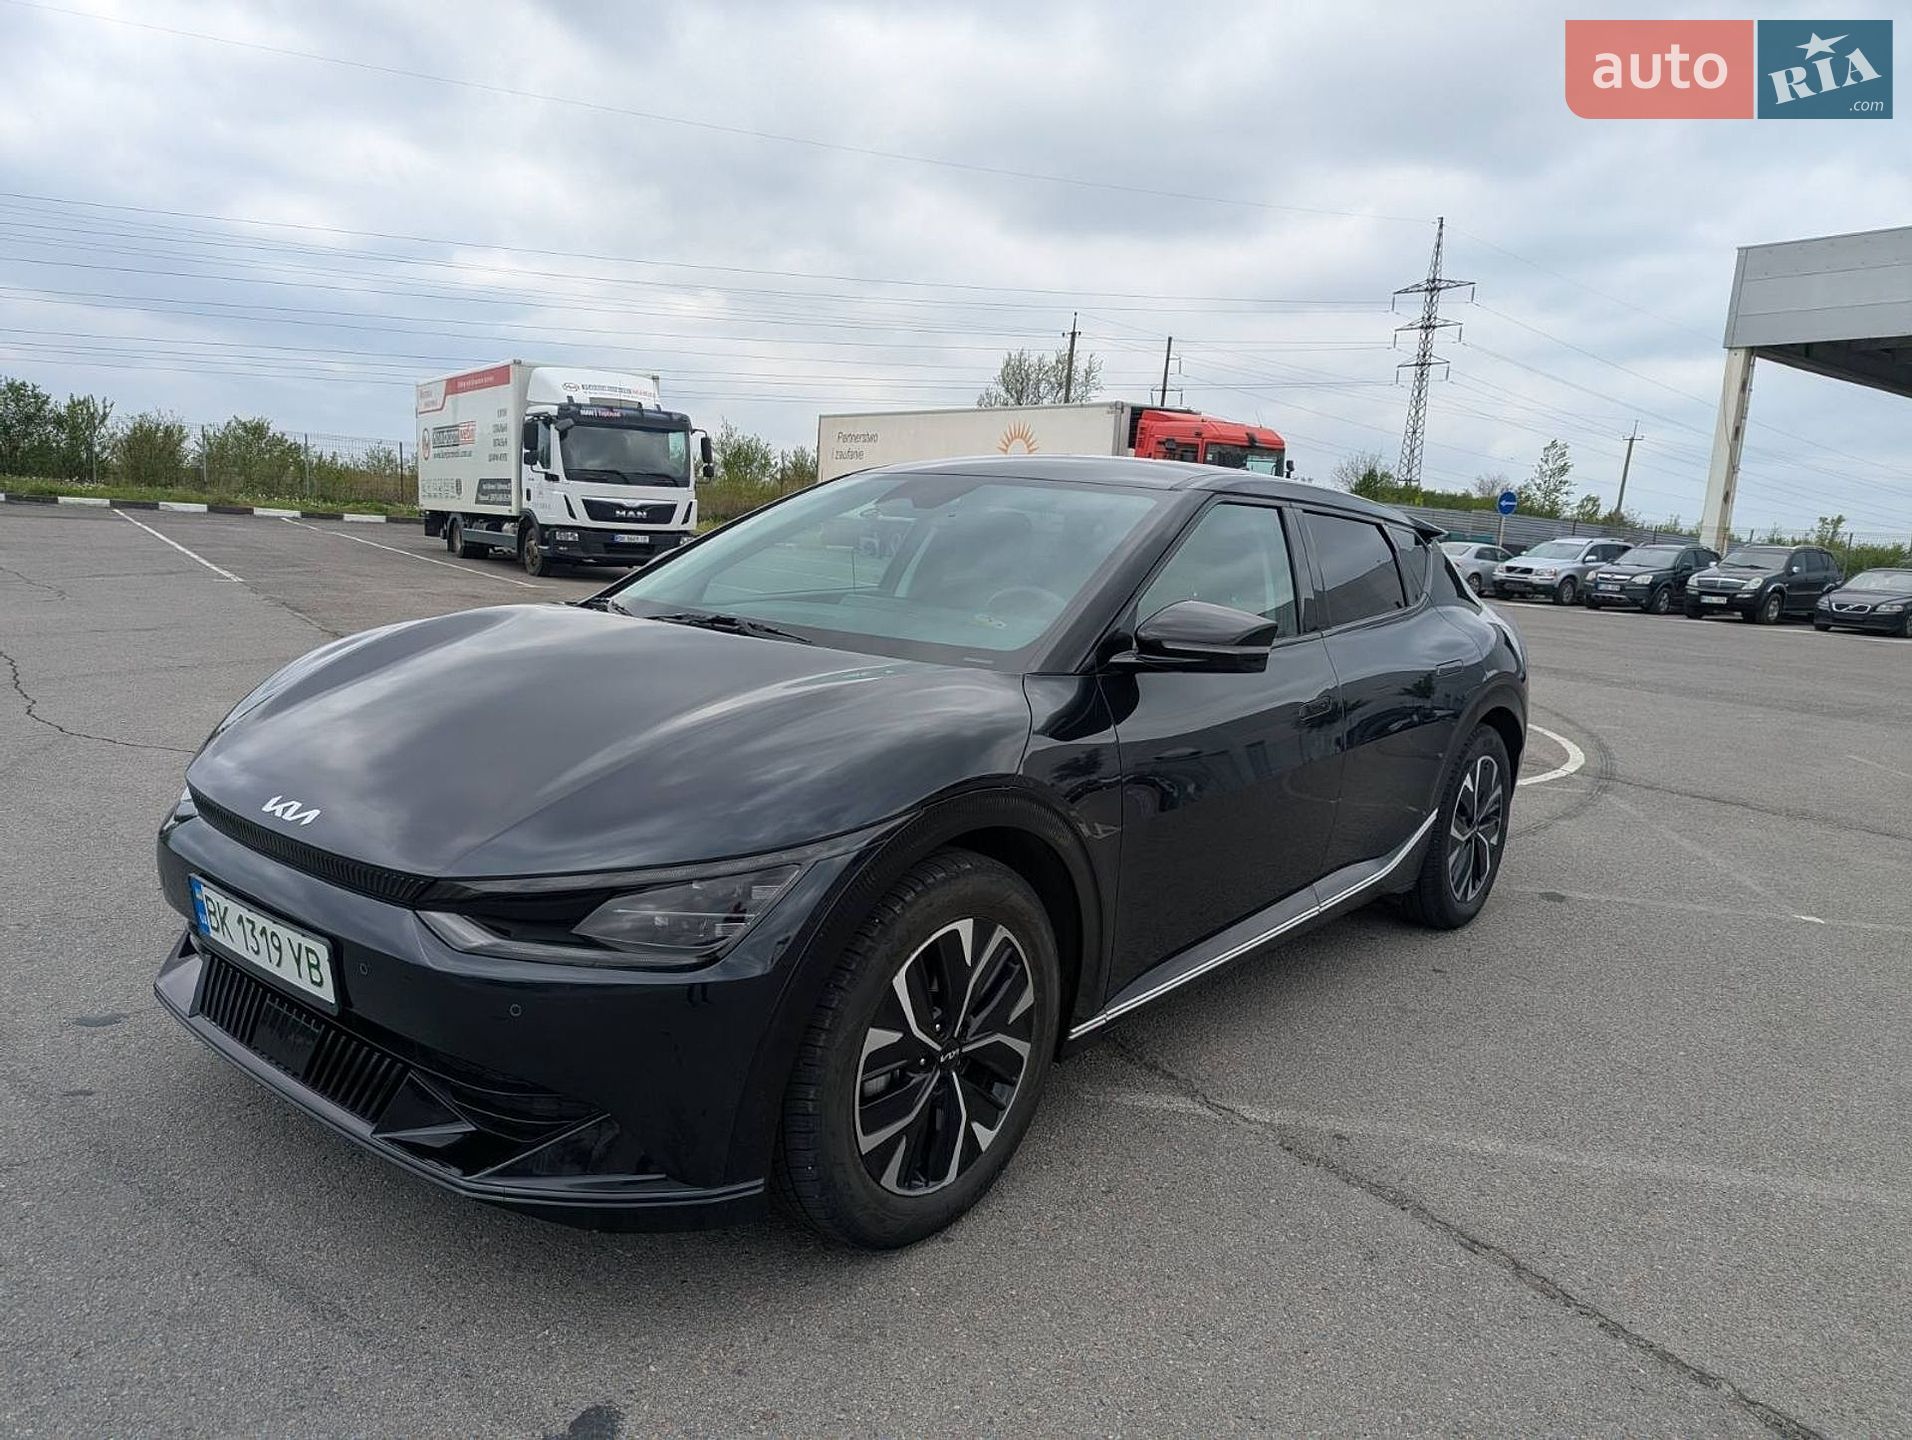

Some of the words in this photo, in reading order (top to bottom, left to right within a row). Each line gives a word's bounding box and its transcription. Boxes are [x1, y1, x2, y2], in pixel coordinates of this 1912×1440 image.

[615, 510, 647, 519] MAN
[204, 894, 235, 943] BK
[237, 914, 283, 968] 1319
[287, 937, 324, 988] YB
